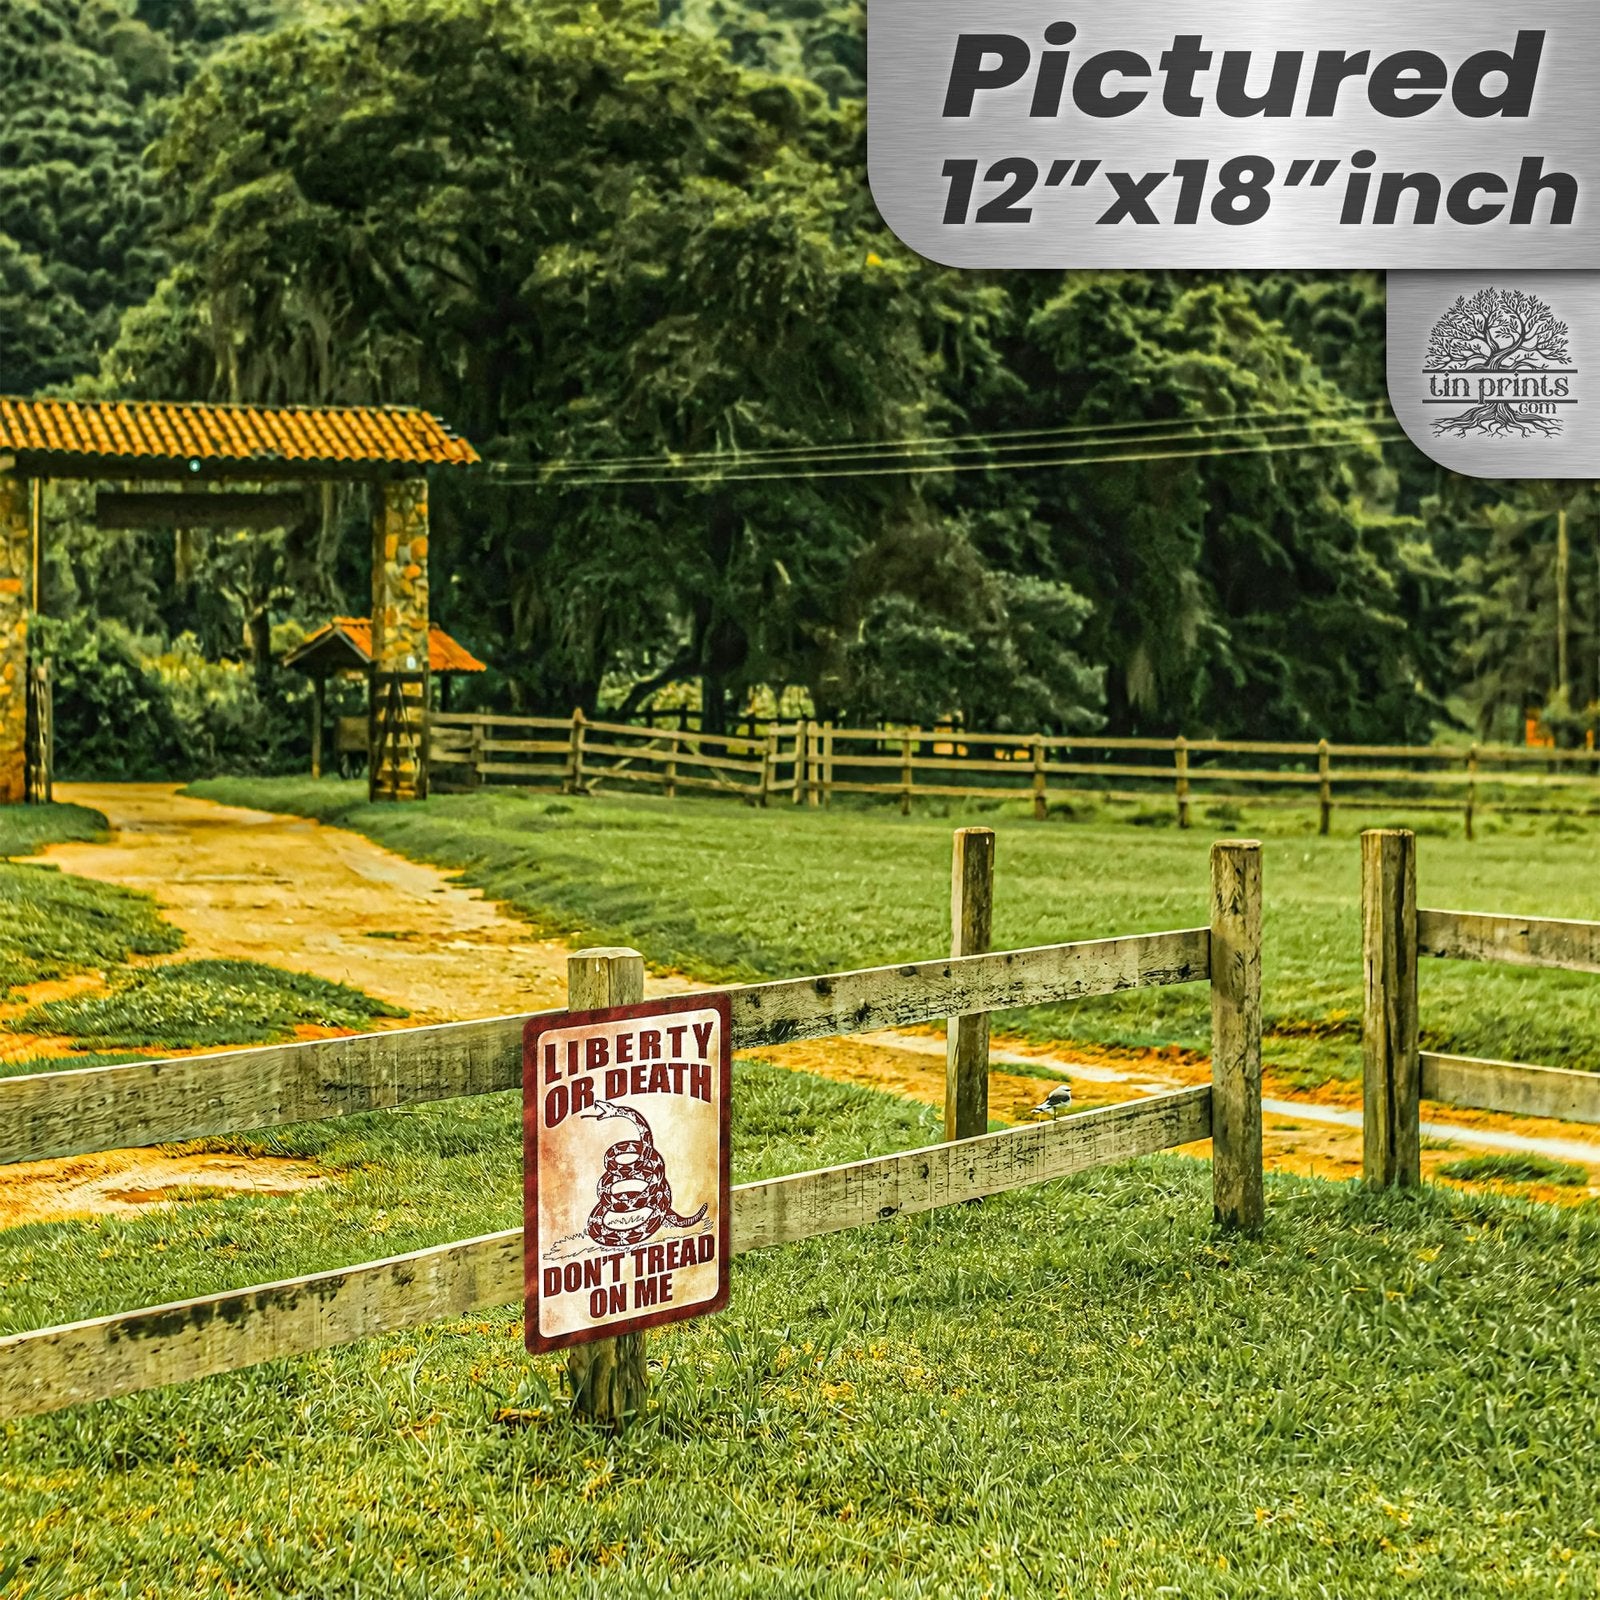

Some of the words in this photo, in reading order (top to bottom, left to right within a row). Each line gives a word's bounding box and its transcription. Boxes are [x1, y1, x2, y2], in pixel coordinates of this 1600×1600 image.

[545, 1022, 714, 1085] LIBERTY
[545, 1076, 594, 1129] OR
[605, 1063, 712, 1104] DEATH
[543, 1252, 626, 1298] DON'T
[631, 1234, 715, 1278] TREAD
[589, 1283, 627, 1319] ON
[634, 1273, 673, 1309] ME
